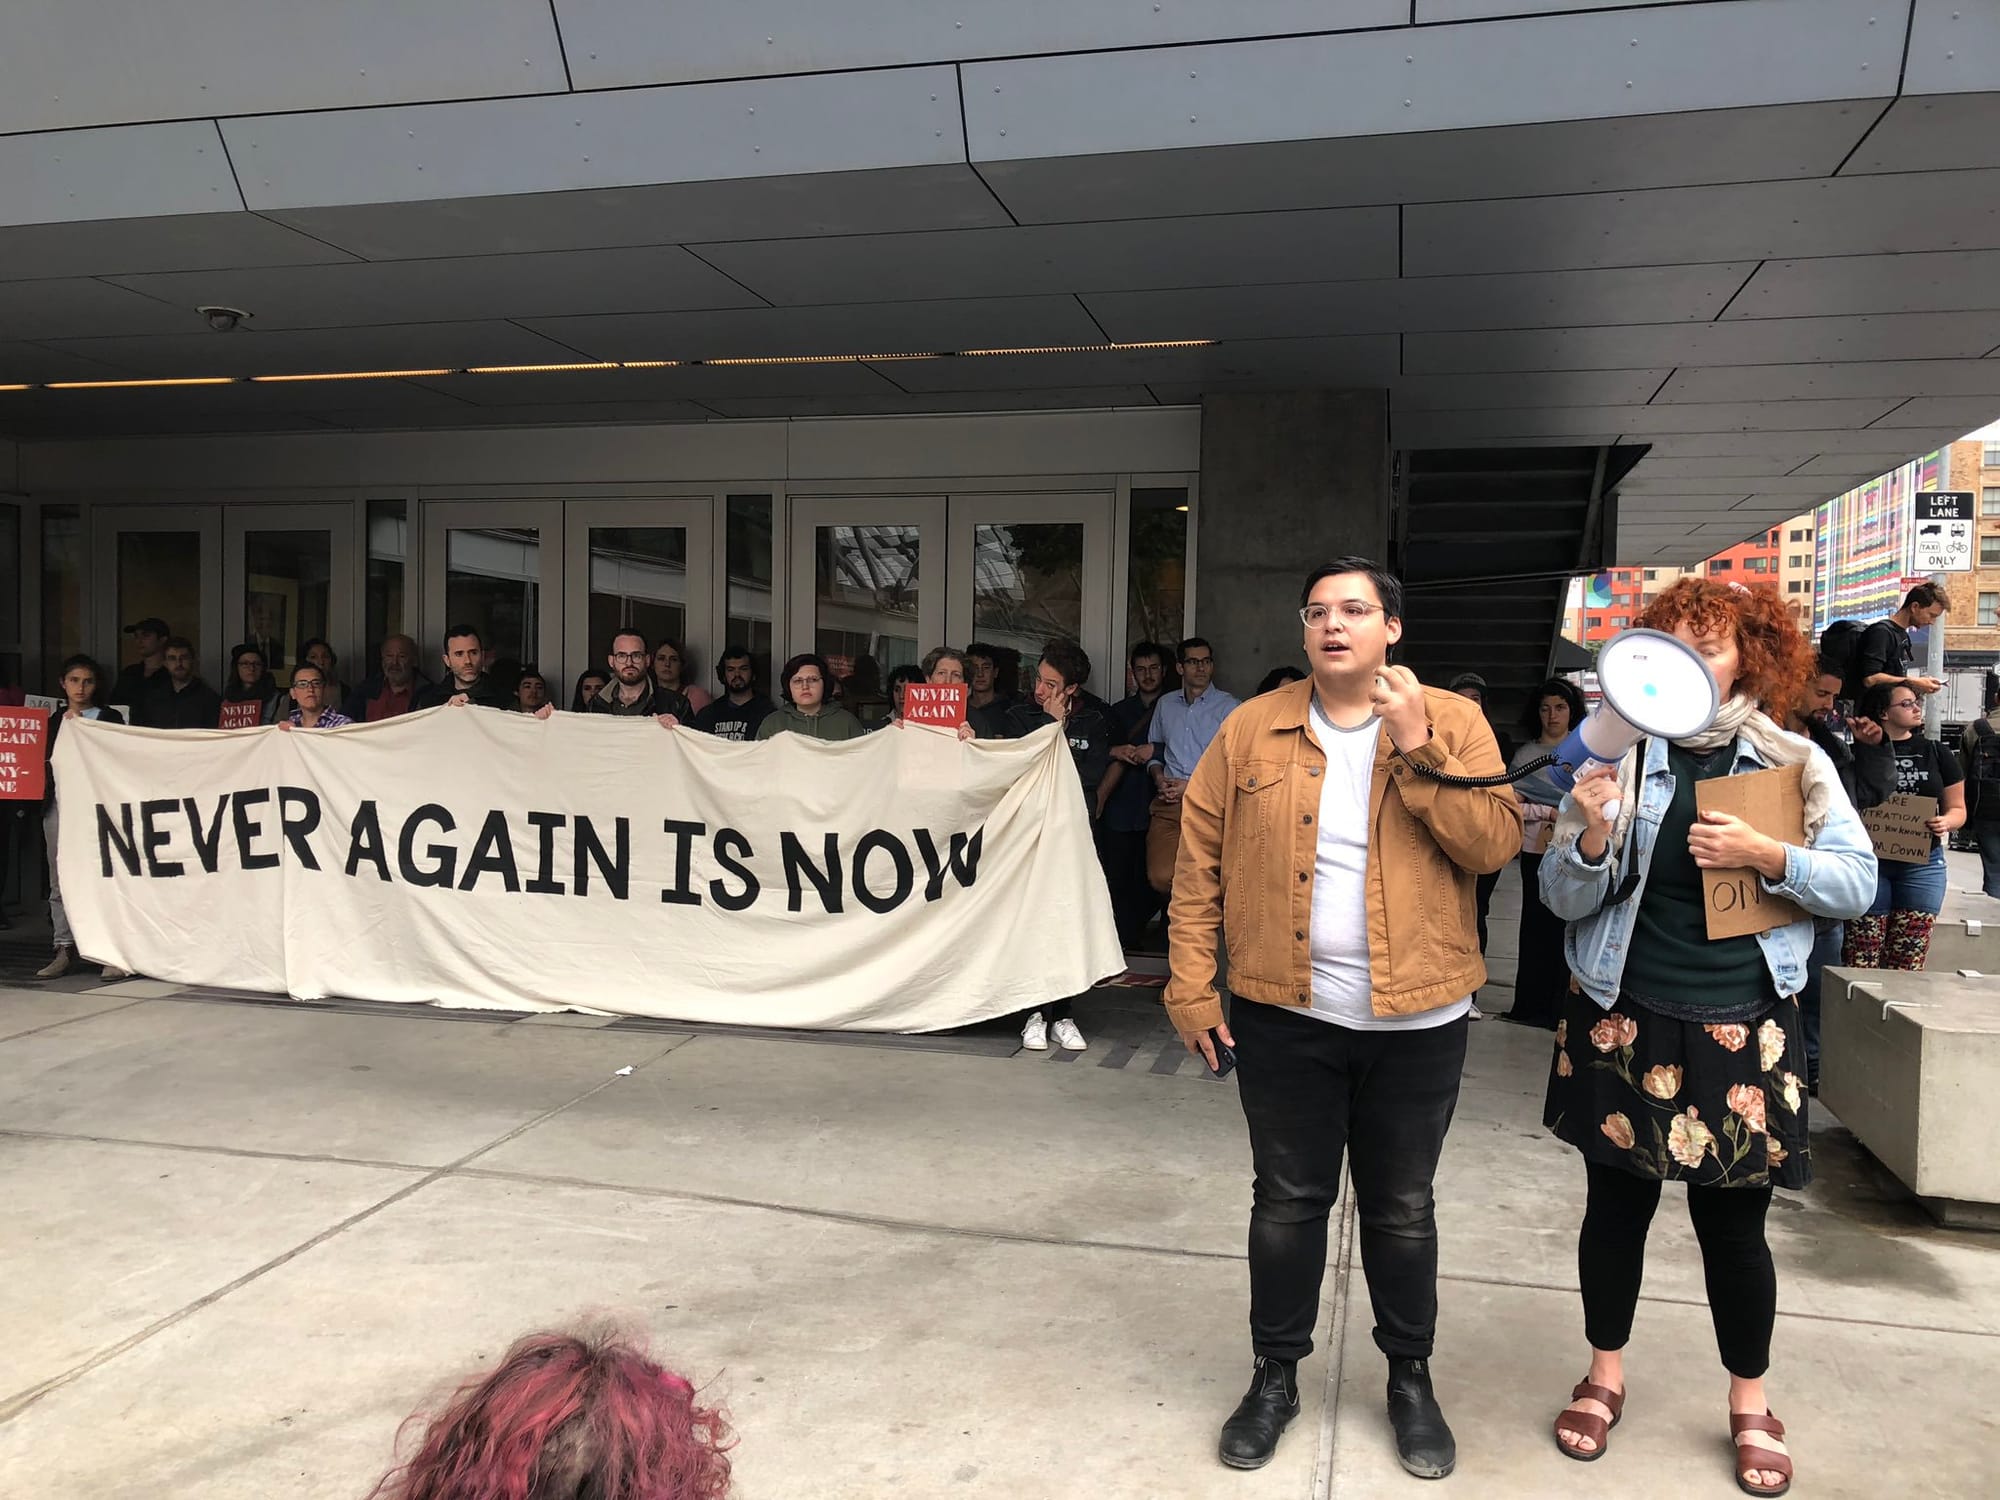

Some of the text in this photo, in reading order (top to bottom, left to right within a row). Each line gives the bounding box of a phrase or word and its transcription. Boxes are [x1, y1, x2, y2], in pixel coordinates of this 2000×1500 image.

[1930, 496, 1958, 506] LEFT
[1929, 508, 1959, 517] LANE
[1928, 556, 1956, 565] ONLY
[910, 688, 960, 702] NEVER
[223, 705, 256, 716] NEVER
[908, 704, 957, 718] AGAIN
[0, 717, 41, 731] EVER
[0, 732, 38, 744] GAIN
[0, 767, 30, 778] NY-
[0, 781, 17, 793] NE
[1862, 809, 1921, 823] NTRATION
[96, 787, 985, 914] NEVER AGAIN IS NOW
[1712, 876, 1760, 912] ON
